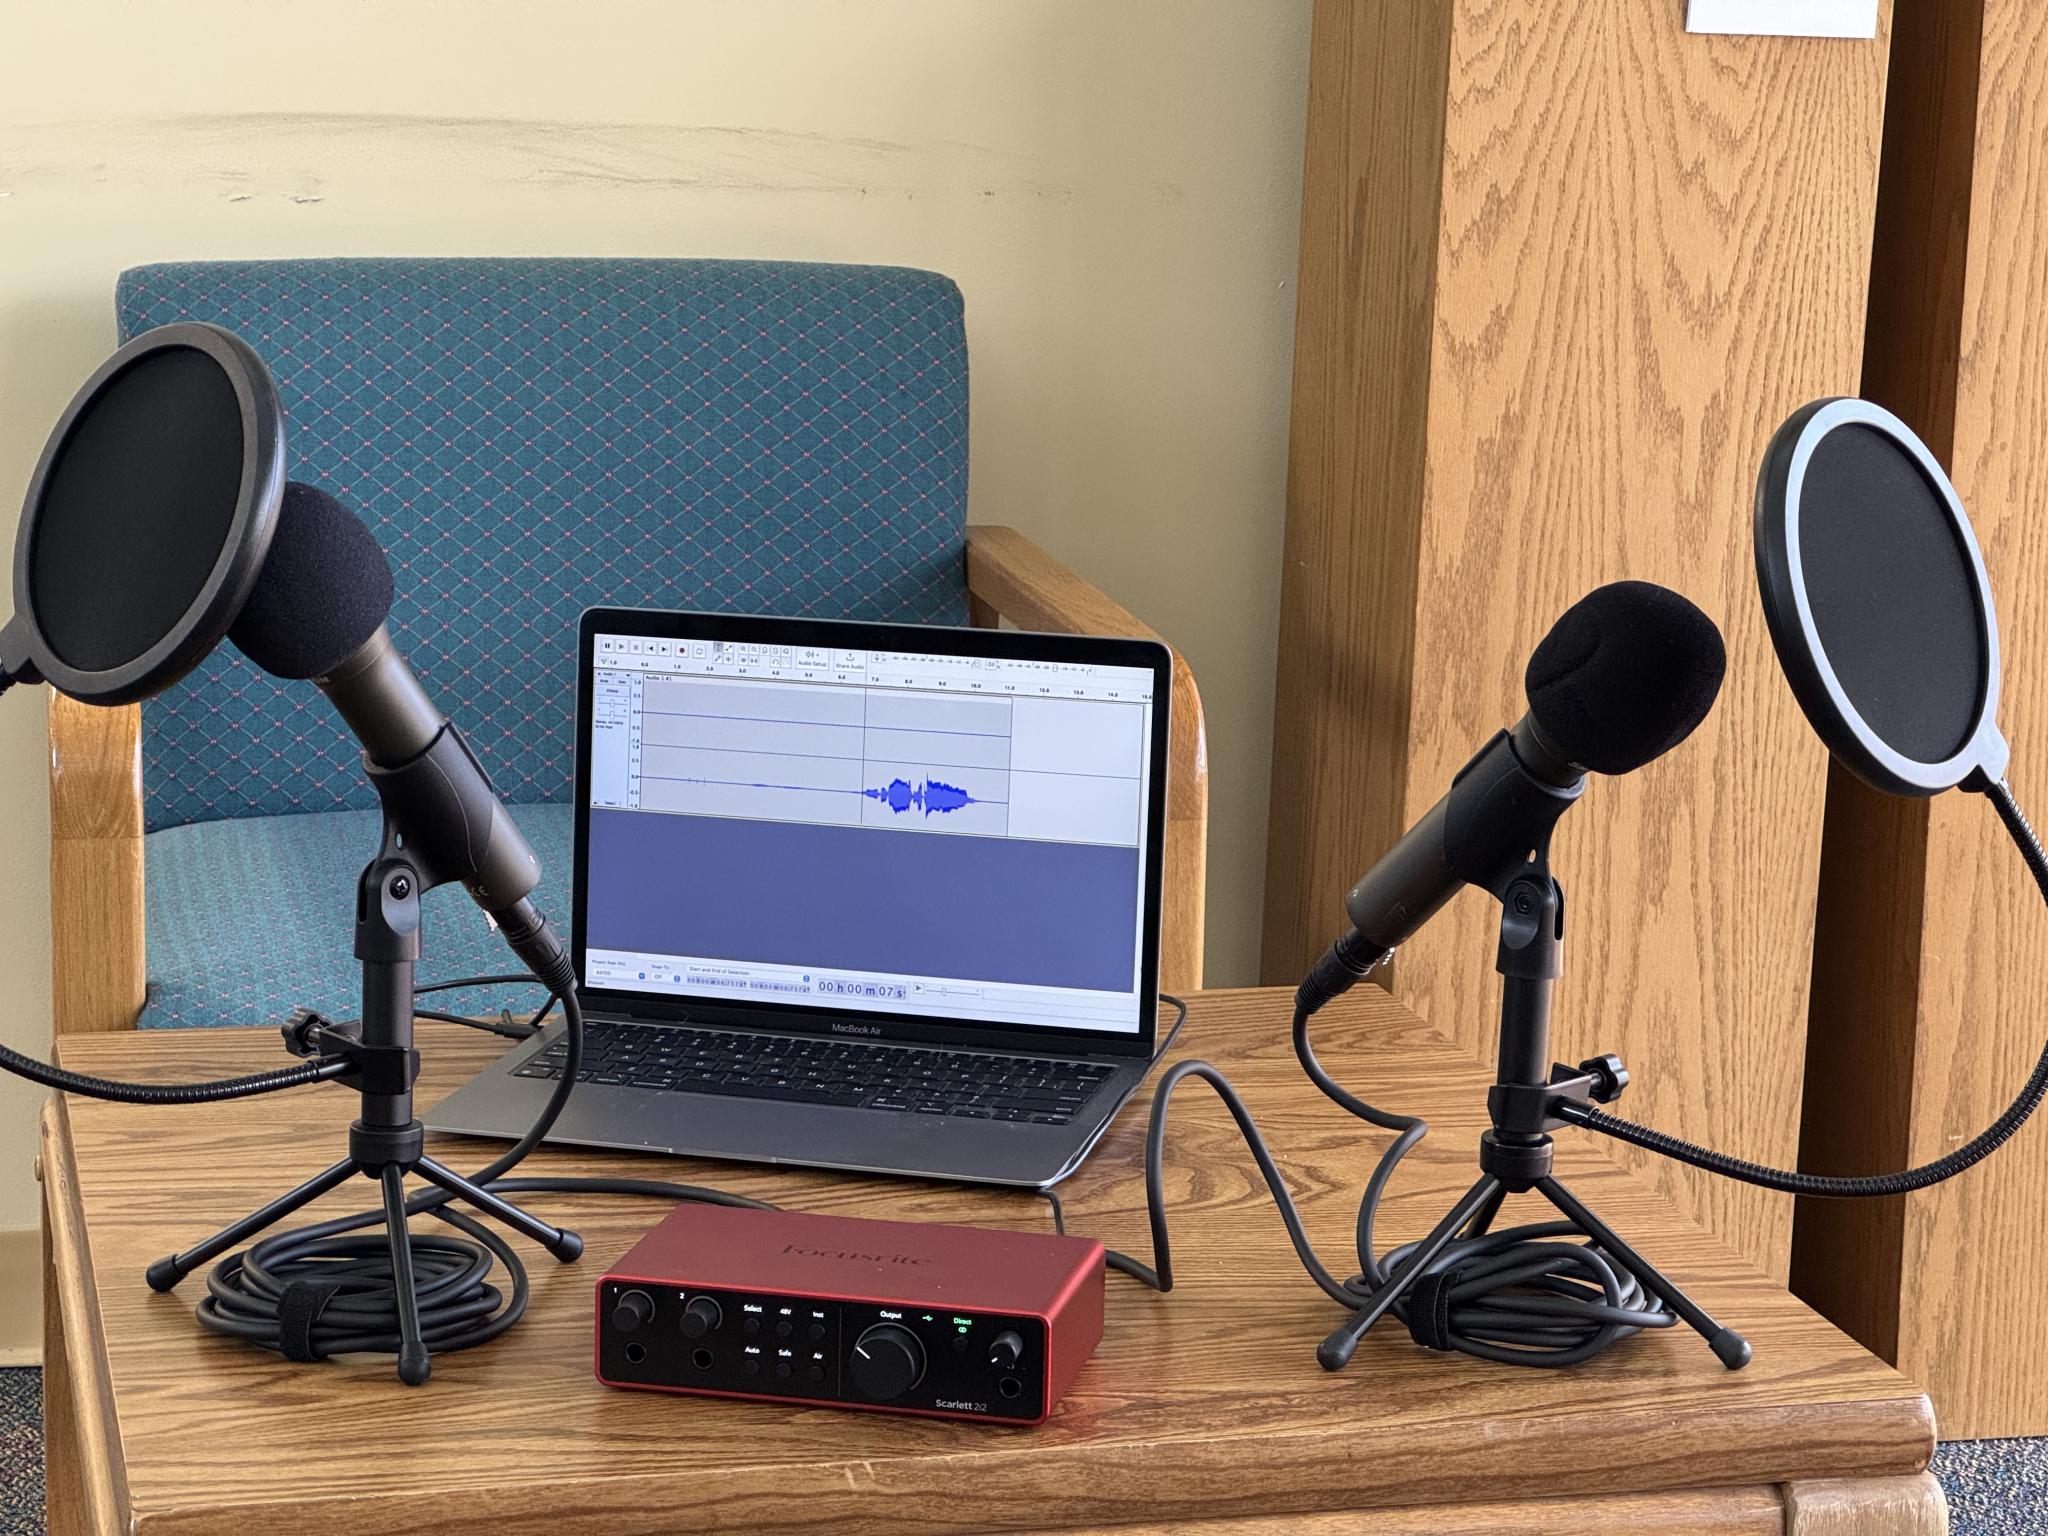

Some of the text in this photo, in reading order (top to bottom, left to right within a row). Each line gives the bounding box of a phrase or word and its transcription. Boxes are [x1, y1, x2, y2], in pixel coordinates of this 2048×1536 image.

[818, 981, 834, 992] 00
[837, 983, 844, 993] h
[847, 983, 862, 994] 00
[865, 987, 875, 995] m
[879, 986, 894, 996] 07
[832, 1023, 882, 1036] MacBook Air
[679, 1292, 685, 1300] 2
[743, 1304, 763, 1313] Select
[812, 1310, 825, 1319] Inst
[880, 1310, 903, 1320] Output
[953, 1317, 972, 1326] Direct
[744, 1346, 761, 1355] Auto
[778, 1349, 792, 1357] Safe
[813, 1352, 823, 1360] Air
[935, 1399, 988, 1412] Scarlett 2i2
